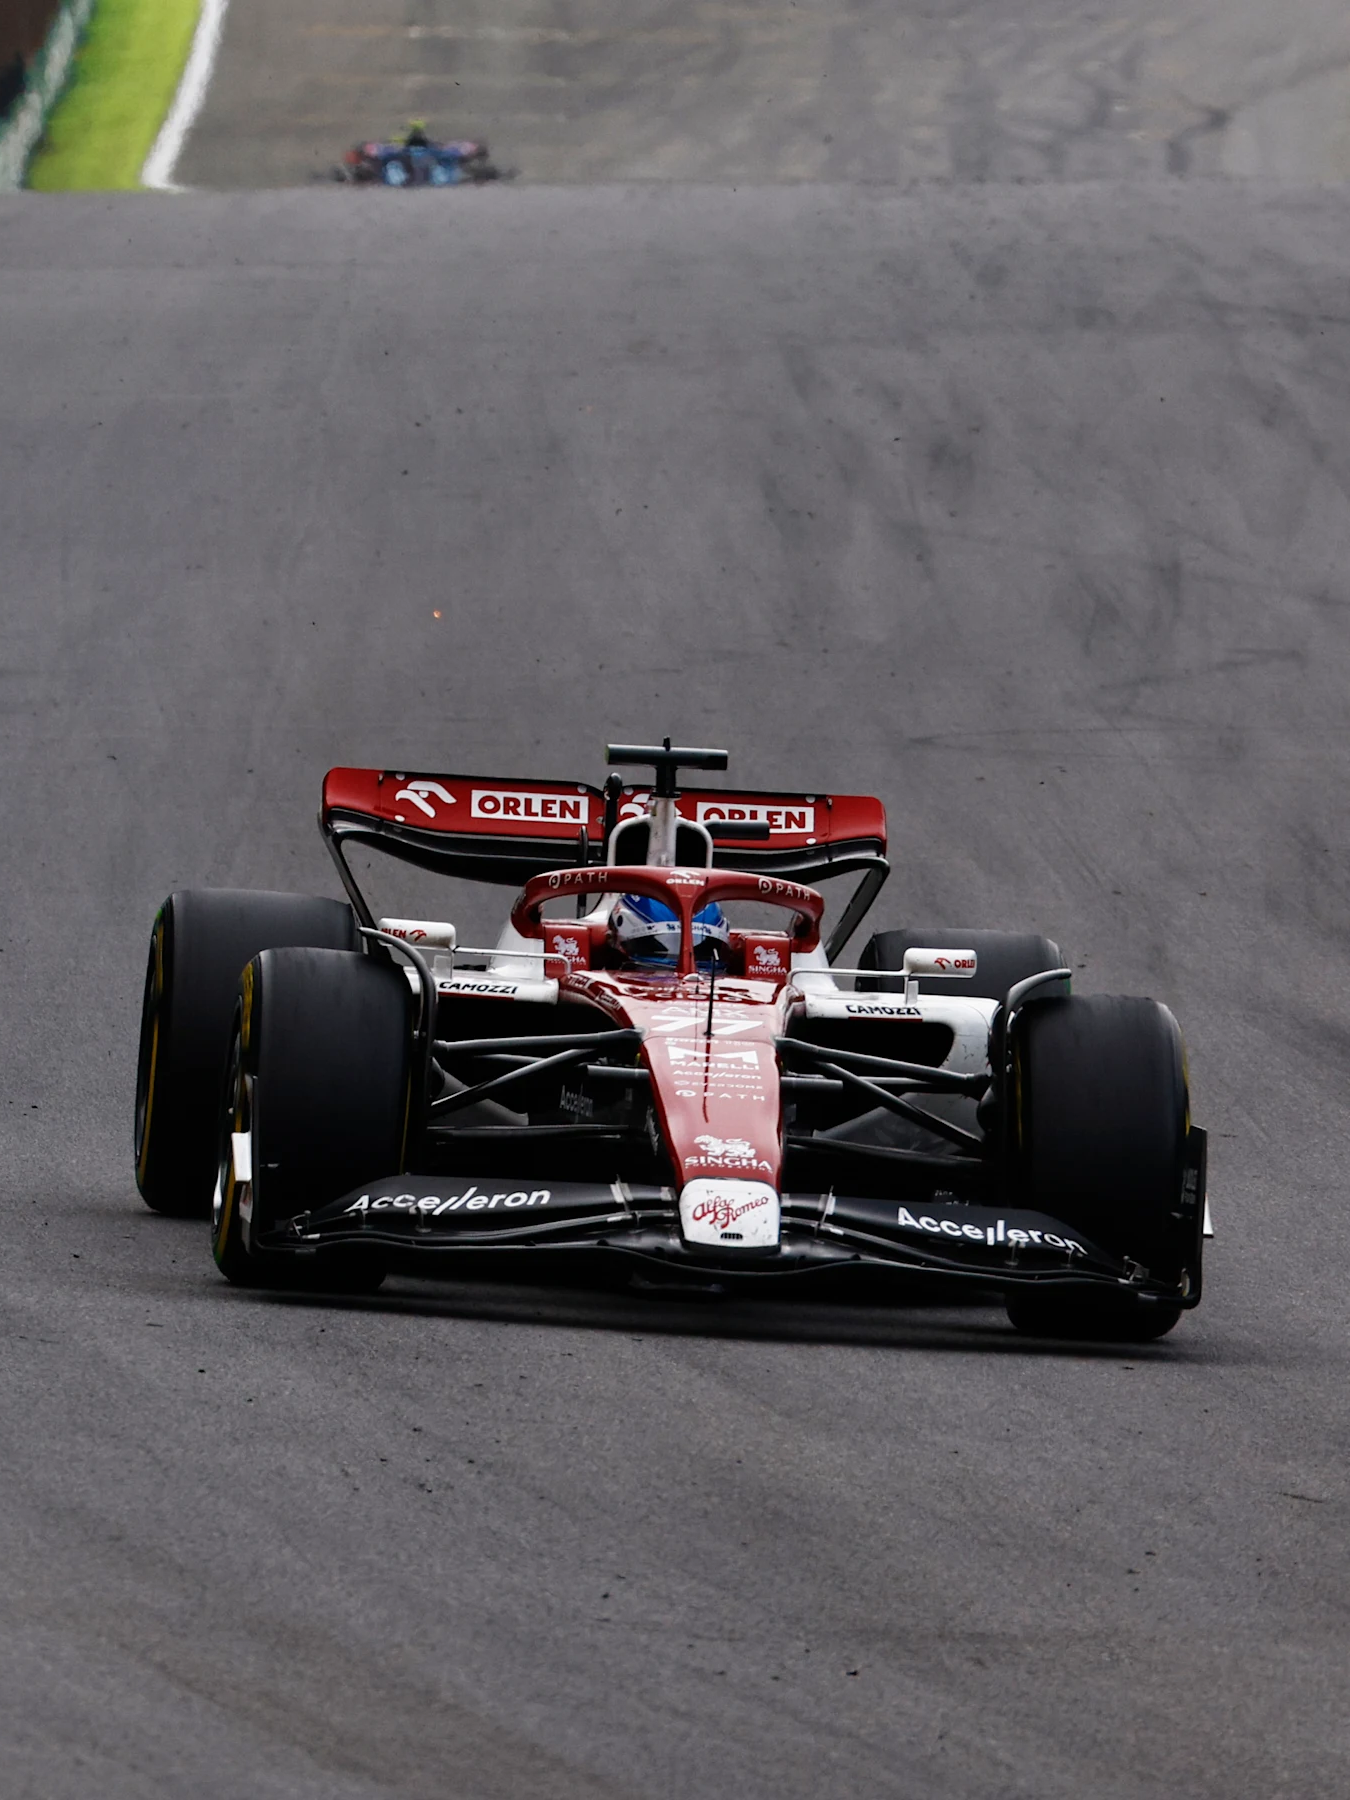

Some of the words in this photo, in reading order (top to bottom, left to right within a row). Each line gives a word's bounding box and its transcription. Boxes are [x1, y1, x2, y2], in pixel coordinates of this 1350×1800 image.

[478, 795, 580, 819] ORLEN
[564, 871, 608, 884] PATH
[666, 878, 705, 886] ORLEN
[776, 884, 810, 901] PATH
[748, 965, 787, 974] SINGHA
[439, 981, 518, 994] CAMOZZI
[846, 1004, 920, 1016] CAMOZZI
[651, 1015, 764, 1035] 77
[670, 1060, 760, 1070] MARELLI
[685, 1156, 772, 1170] SINGHA
[693, 1196, 734, 1224] Alfa
[716, 1196, 769, 1229] Romeo
